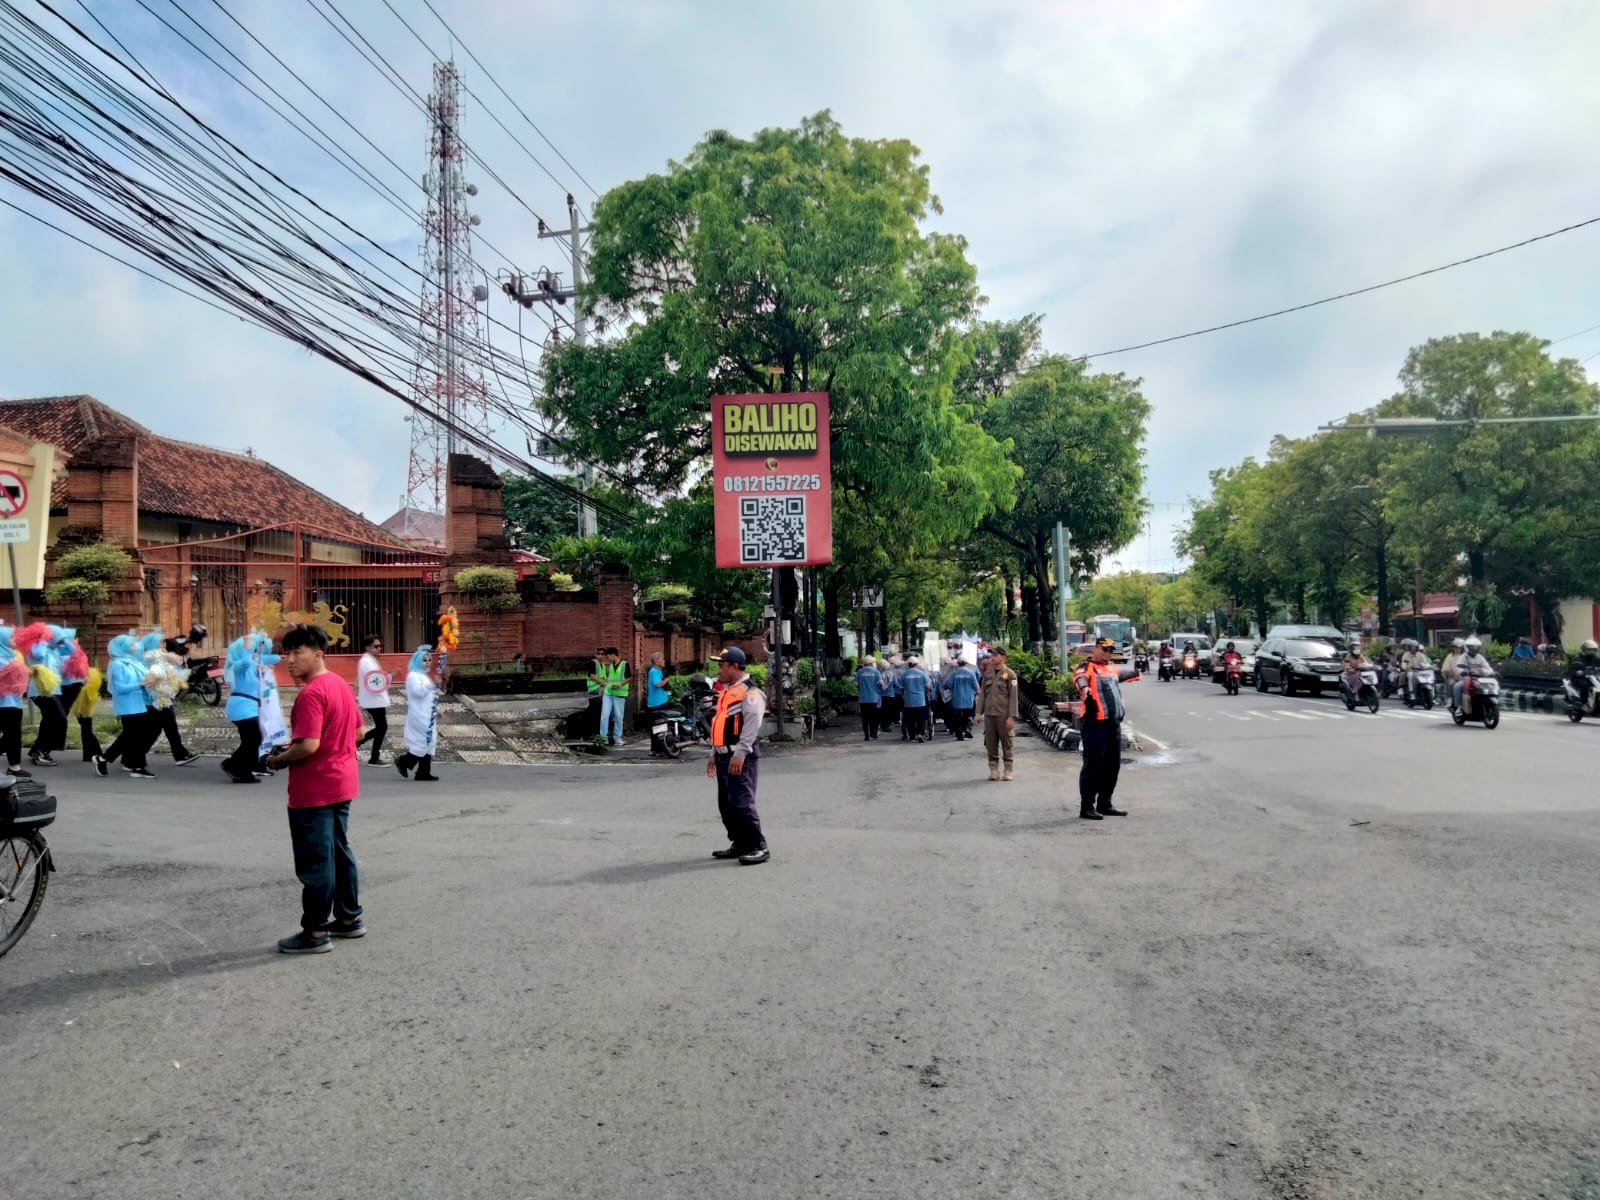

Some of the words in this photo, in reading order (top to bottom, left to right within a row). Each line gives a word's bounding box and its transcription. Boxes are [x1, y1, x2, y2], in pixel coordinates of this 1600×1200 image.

[723, 402, 817, 432] BALIHO
[724, 433, 817, 452] DISEWAKAN
[723, 474, 821, 492] 08121557225
